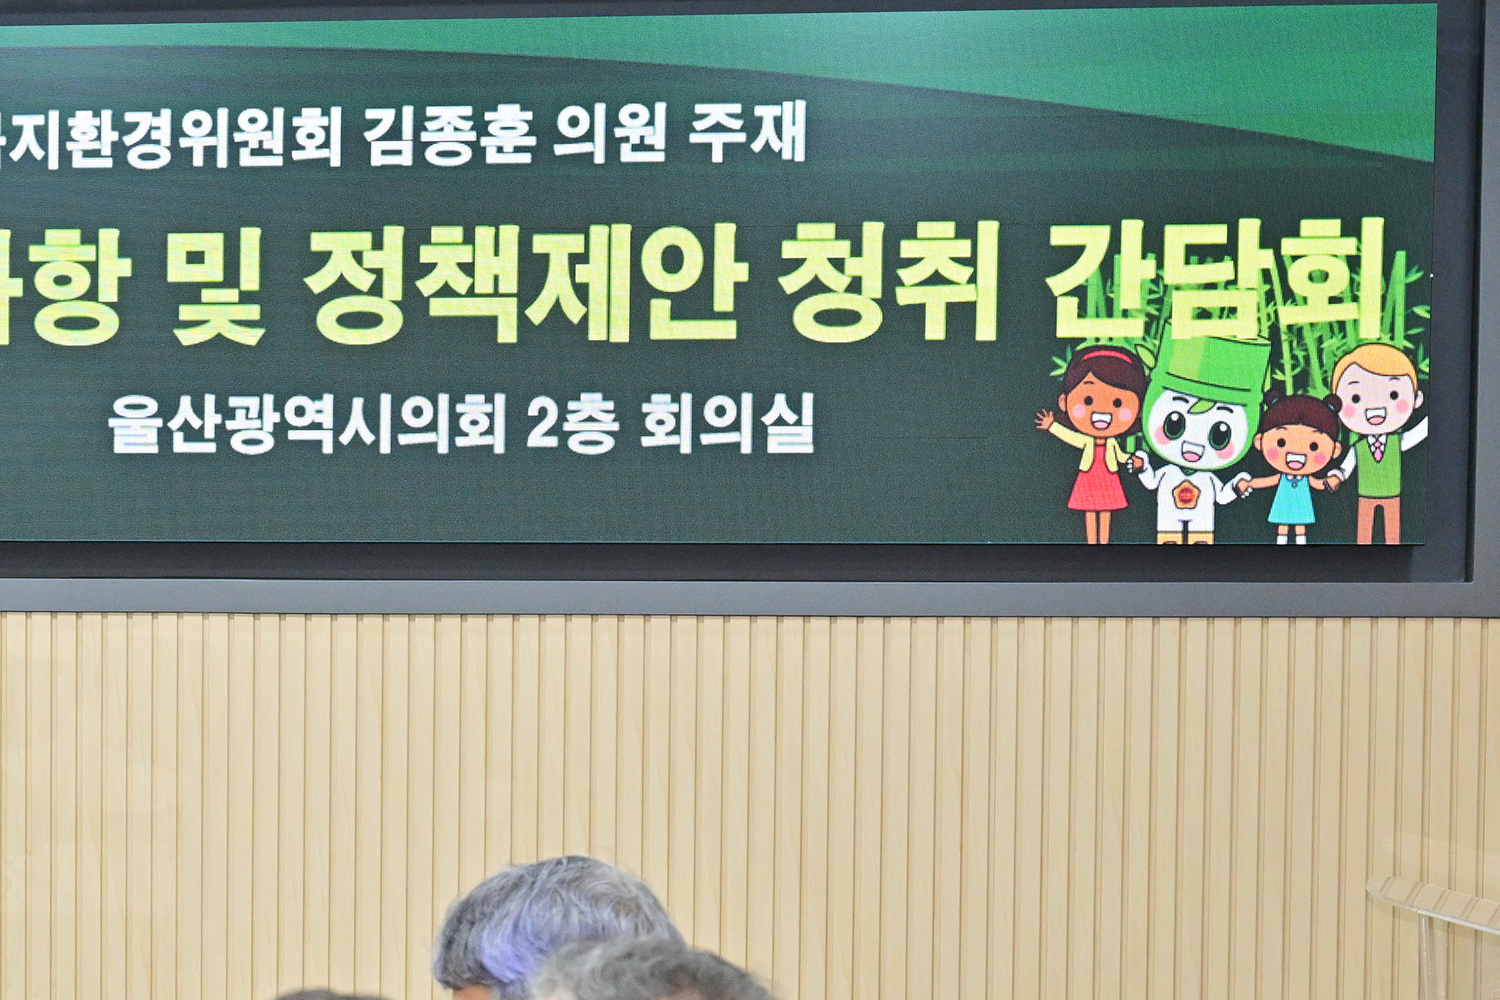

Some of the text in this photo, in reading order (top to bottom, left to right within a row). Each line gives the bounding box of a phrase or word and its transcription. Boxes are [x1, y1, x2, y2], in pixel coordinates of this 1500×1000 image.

[363, 104, 538, 168] 김종훈
[553, 102, 668, 167] 의원
[689, 99, 808, 164] 주재
[168, 228, 267, 347] 및
[303, 223, 750, 346] 정책제안
[778, 221, 1001, 344] 청취
[1045, 217, 1386, 343] 간담회
[108, 392, 815, 457] 울산광역시의회 2층 회의실
